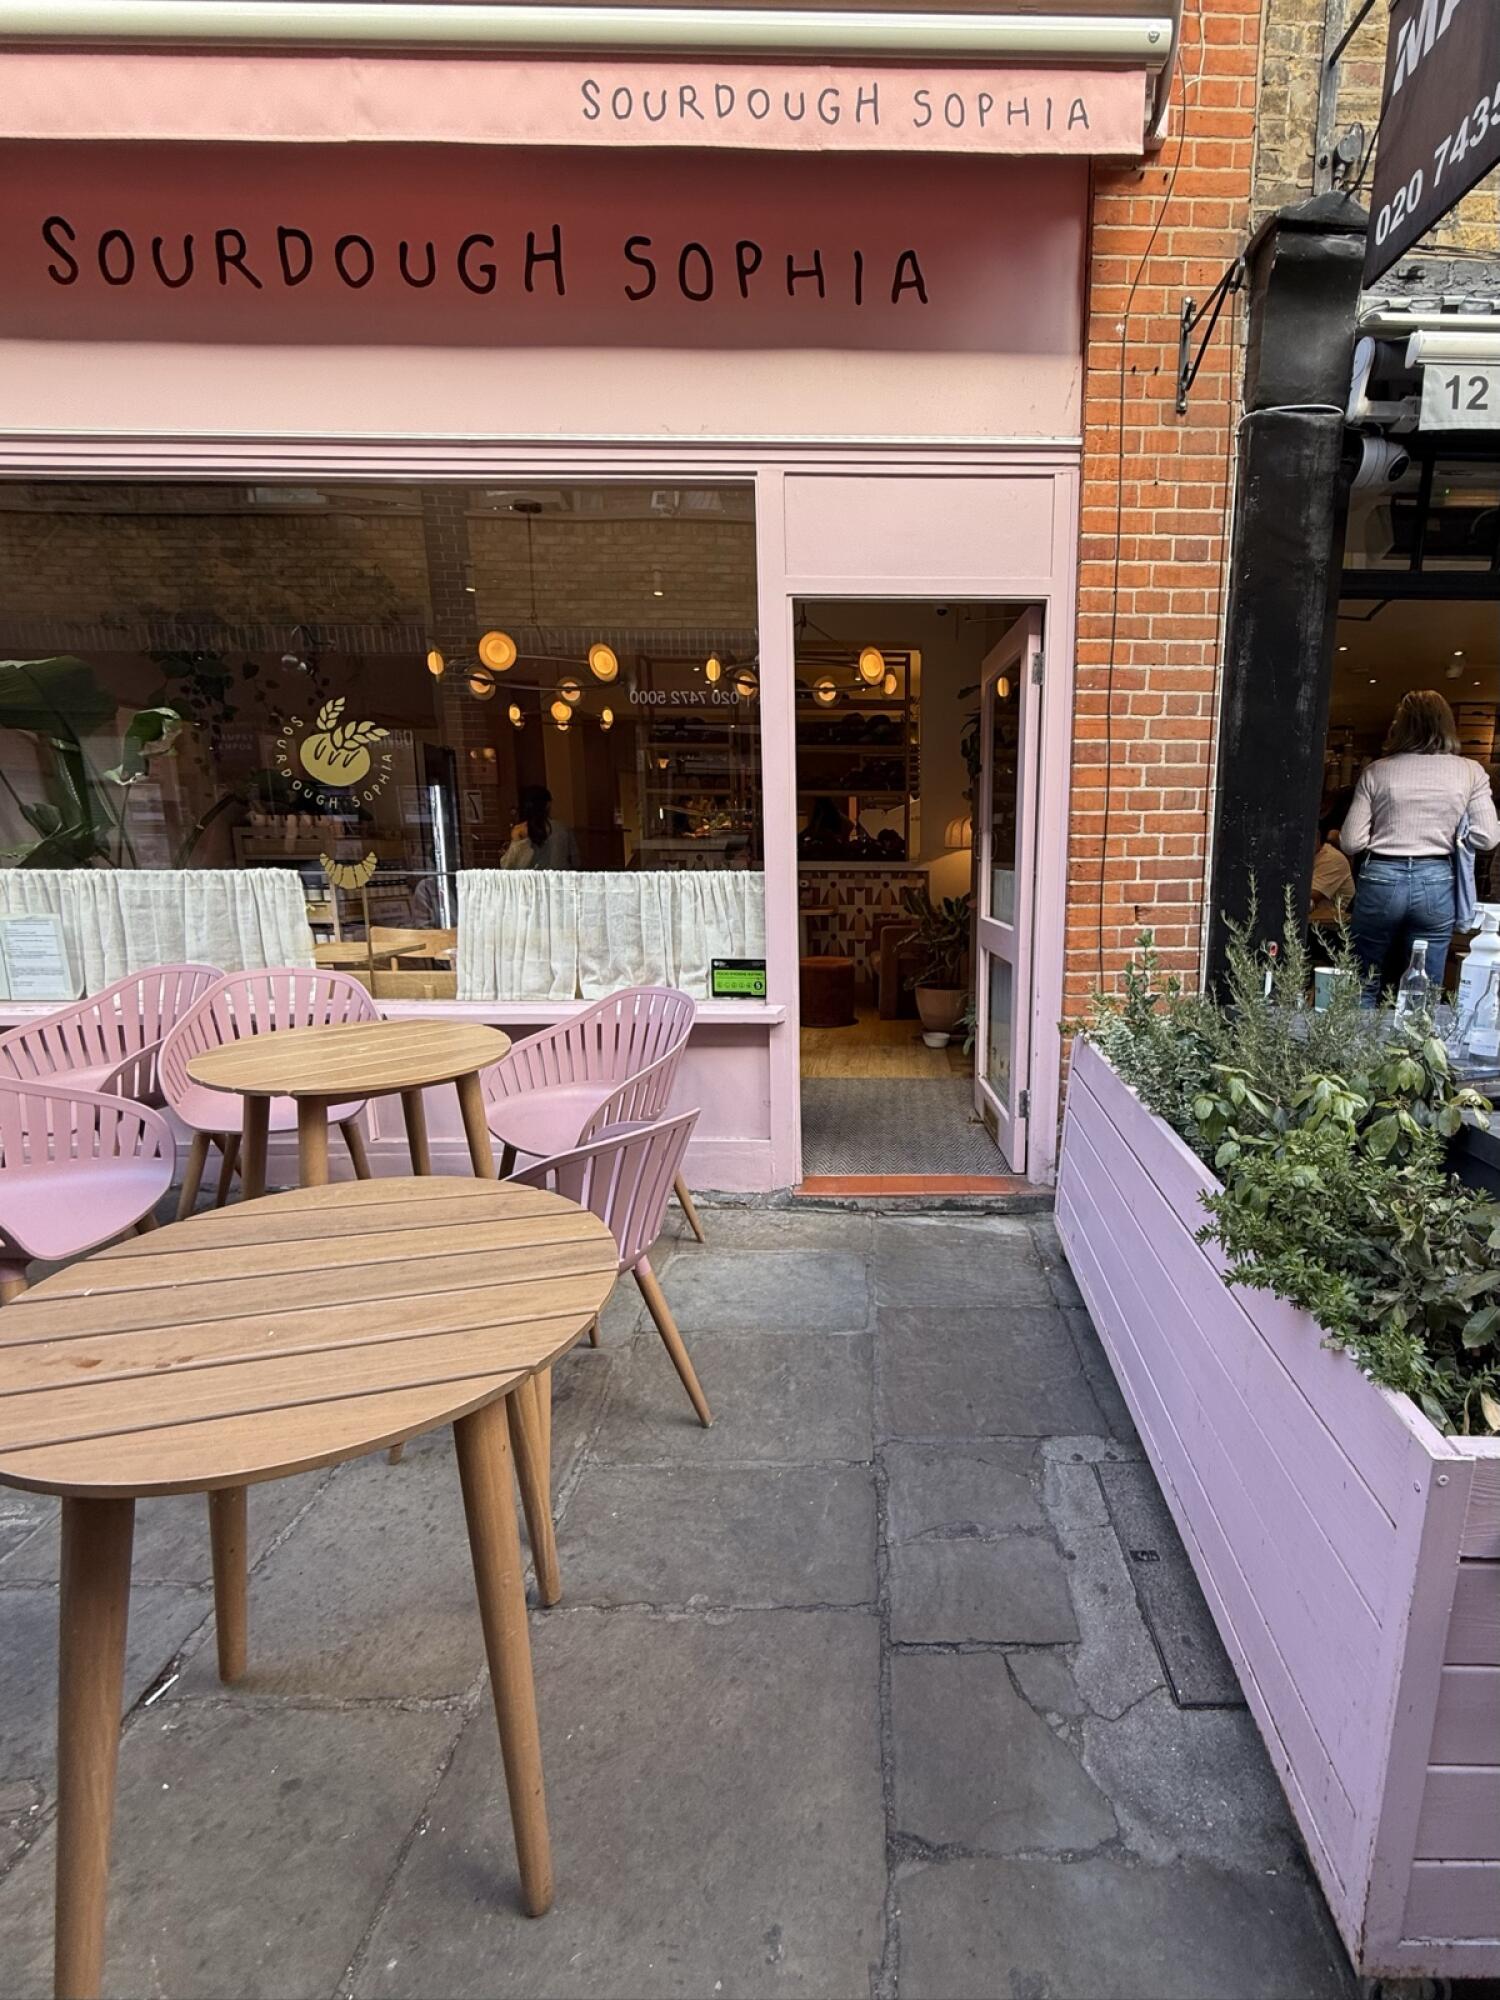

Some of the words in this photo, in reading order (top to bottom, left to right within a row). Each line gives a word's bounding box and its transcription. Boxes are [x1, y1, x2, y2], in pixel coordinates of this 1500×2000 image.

[581, 79, 880, 126] SOURDOUGH
[913, 89, 1090, 130] SOPHIA
[1375, 168, 1424, 246] 020
[42, 216, 565, 296] SOURDOUGH
[624, 236, 929, 306] SOPHIA
[1445, 374, 1490, 411] 12
[276, 715, 338, 810] SOURDOUGH
[352, 753, 393, 808] SOPHIA
